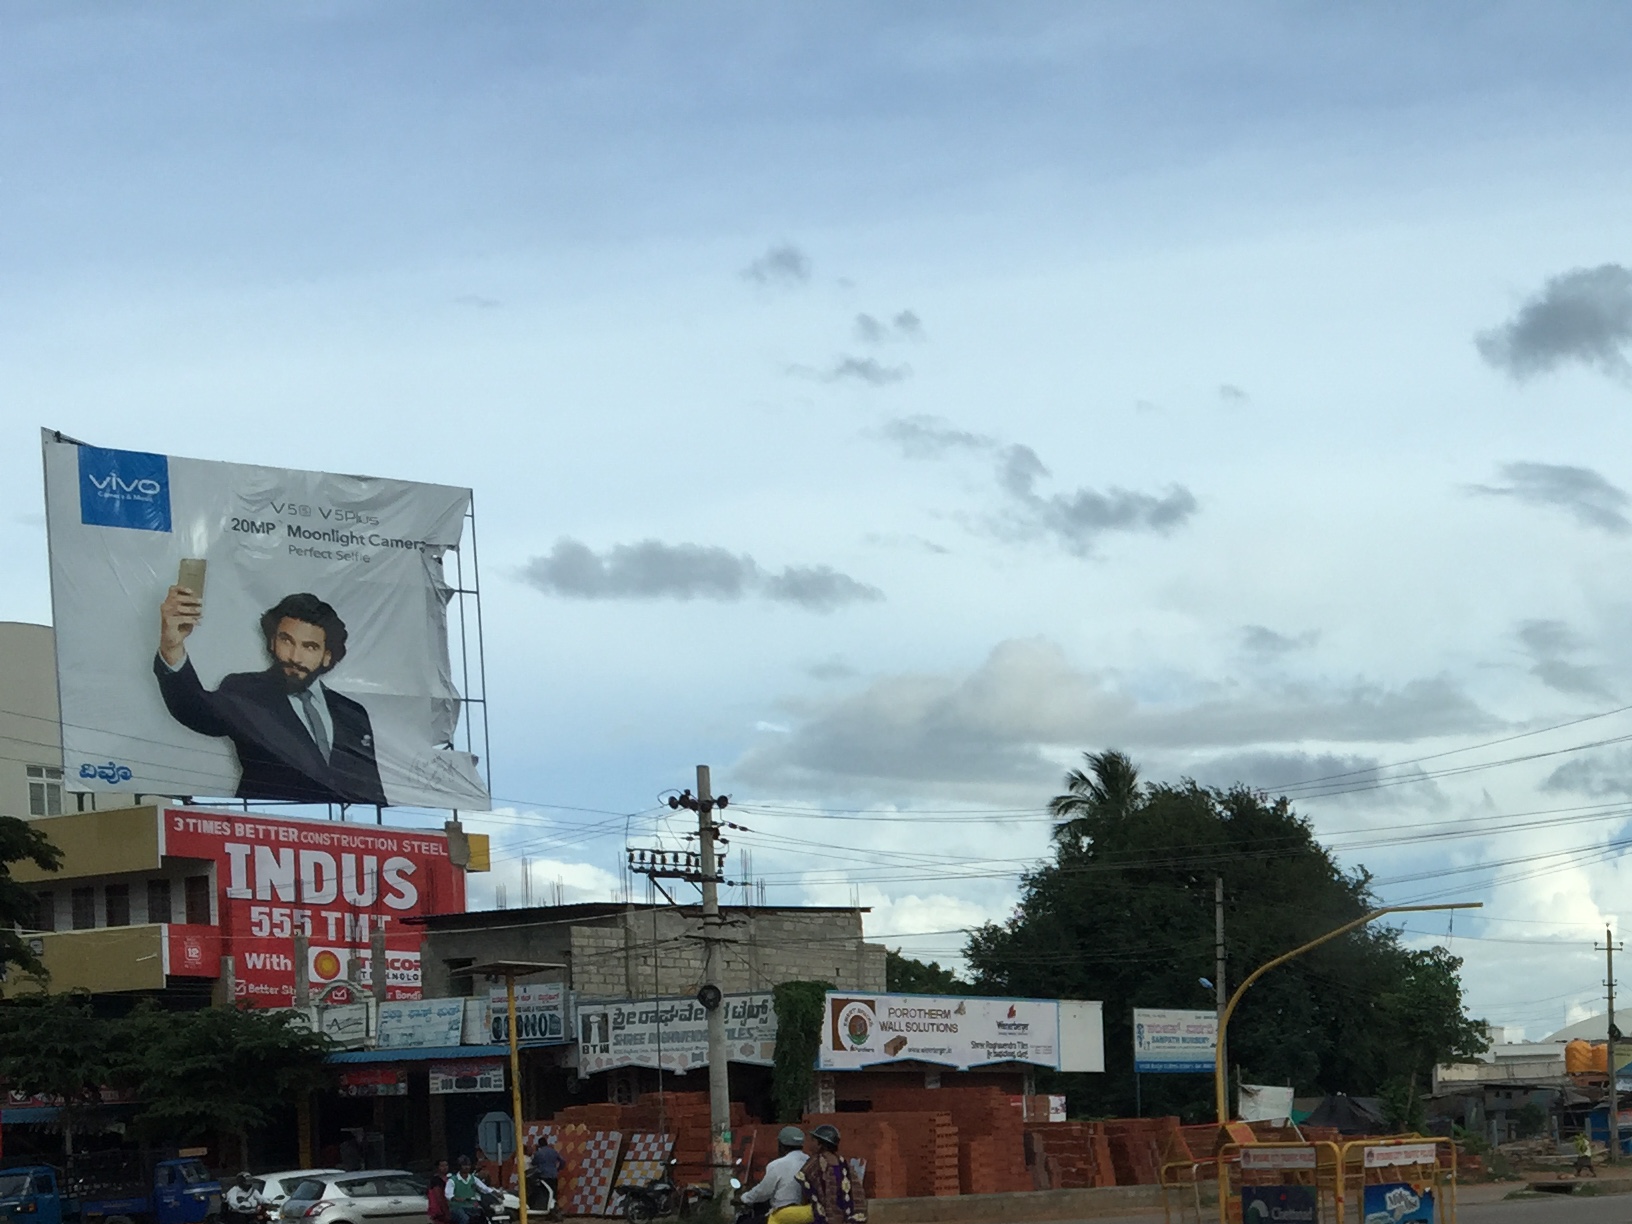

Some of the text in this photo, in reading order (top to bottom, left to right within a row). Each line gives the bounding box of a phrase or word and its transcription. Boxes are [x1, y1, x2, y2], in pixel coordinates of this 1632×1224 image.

[89, 470, 160, 495] vivo
[231, 517, 276, 535] 20MP
[287, 524, 365, 548] Moonlight
[288, 545, 371, 564] Perfect Selfie
[174, 817, 448, 856] 3 TIMES BETTER CONSTRUCTION STEEL
[224, 842, 418, 910] INDUS
[250, 906, 391, 943] 555 TMT
[244, 952, 292, 971] With
[248, 983, 279, 995] Better
[888, 1007, 952, 1019] POROTHERM
[880, 1021, 958, 1033] WALL SOLUTIONS
[582, 1043, 610, 1055] BTW
